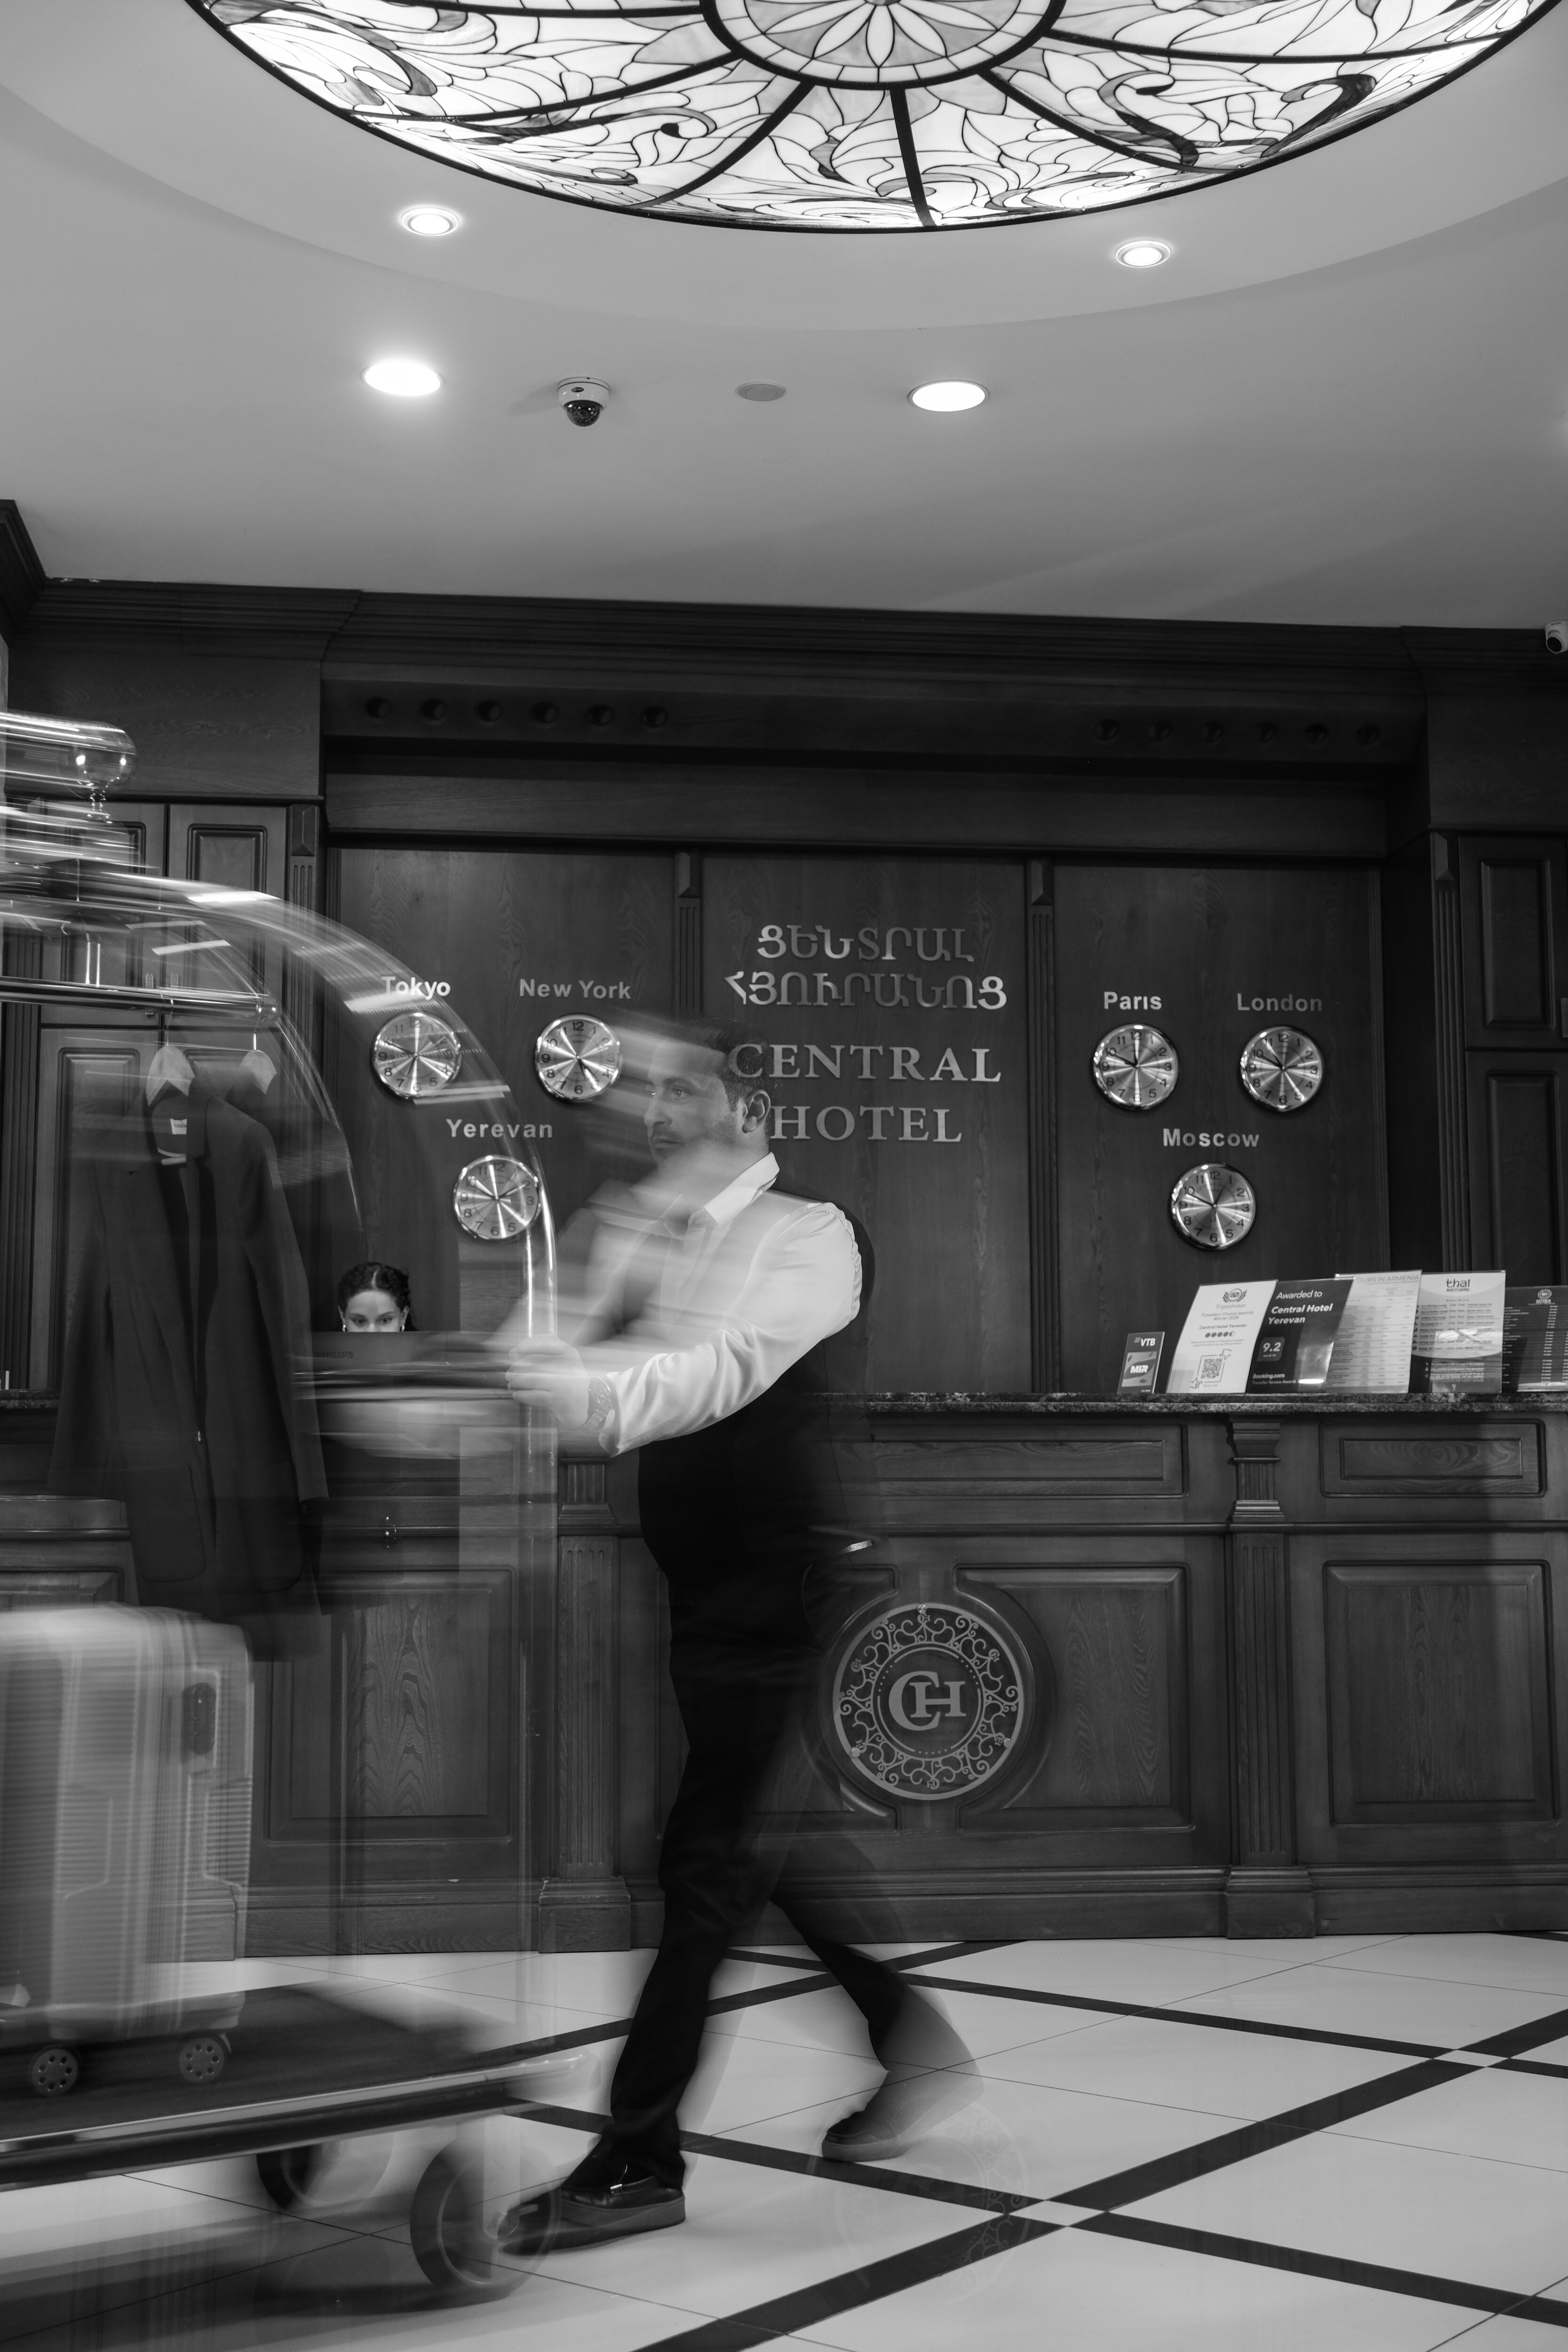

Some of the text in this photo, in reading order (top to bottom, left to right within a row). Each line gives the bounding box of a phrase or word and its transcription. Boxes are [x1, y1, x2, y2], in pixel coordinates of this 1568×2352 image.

[757, 925, 974, 962] ՑԵՆՏՐԱԼ
[382, 976, 451, 1000] Tokyo
[520, 979, 631, 999] New York
[1237, 993, 1322, 1012] London
[395, 1025, 403, 1033] 11
[573, 1022, 584, 1031] 12
[1278, 1033, 1289, 1042] 12
[379, 1052, 387, 1060] 9
[1106, 1048, 1116, 1056] 10
[1305, 1050, 1313, 1059] 2
[542, 1054, 550, 1062] 9
[728, 1043, 1001, 1082] CENTRAL
[1102, 1062, 1109, 1071] 9
[1164, 1063, 1171, 1071] 3
[1311, 1065, 1317, 1074] 3
[384, 1067, 392, 1076] 8
[547, 1069, 555, 1078] 8
[397, 1079, 404, 1087] 7
[429, 1078, 438, 1086] 5
[559, 1081, 566, 1089] 7
[1106, 1077, 1114, 1086] 8
[1253, 1079, 1260, 1087] 8
[575, 1085, 583, 1094] 6
[1149, 1089, 1156, 1097] 5
[1279, 1095, 1287, 1104] 6
[771, 1105, 962, 1142] HOTEL
[446, 1119, 553, 1138] Yerevan
[1163, 1128, 1259, 1147] Moscow
[479, 1167, 486, 1175] 11
[494, 1163, 505, 1171] 12
[1196, 1175, 1203, 1184] 11
[522, 1180, 530, 1189] 2
[1184, 1186, 1194, 1195] 10
[1237, 1188, 1244, 1196] 2
[526, 1196, 534, 1205] 3
[464, 1208, 471, 1217] 8
[1242, 1204, 1249, 1212] 3
[1184, 1216, 1191, 1225] 8
[476, 1221, 484, 1230] 7
[508, 1223, 516, 1232] 5
[491, 1227, 499, 1236] 6
[1226, 1229, 1234, 1238] 5
[1210, 1233, 1218, 1242] 6
[1446, 1279, 1471, 1287] thai
[1276, 1290, 1313, 1300] Awarded
[1271, 1303, 1333, 1314] Central Hotel
[1141, 1338, 1155, 1347] VTB
[1263, 1342, 1281, 1352] 9.2
[1130, 1365, 1148, 1374] MIR
